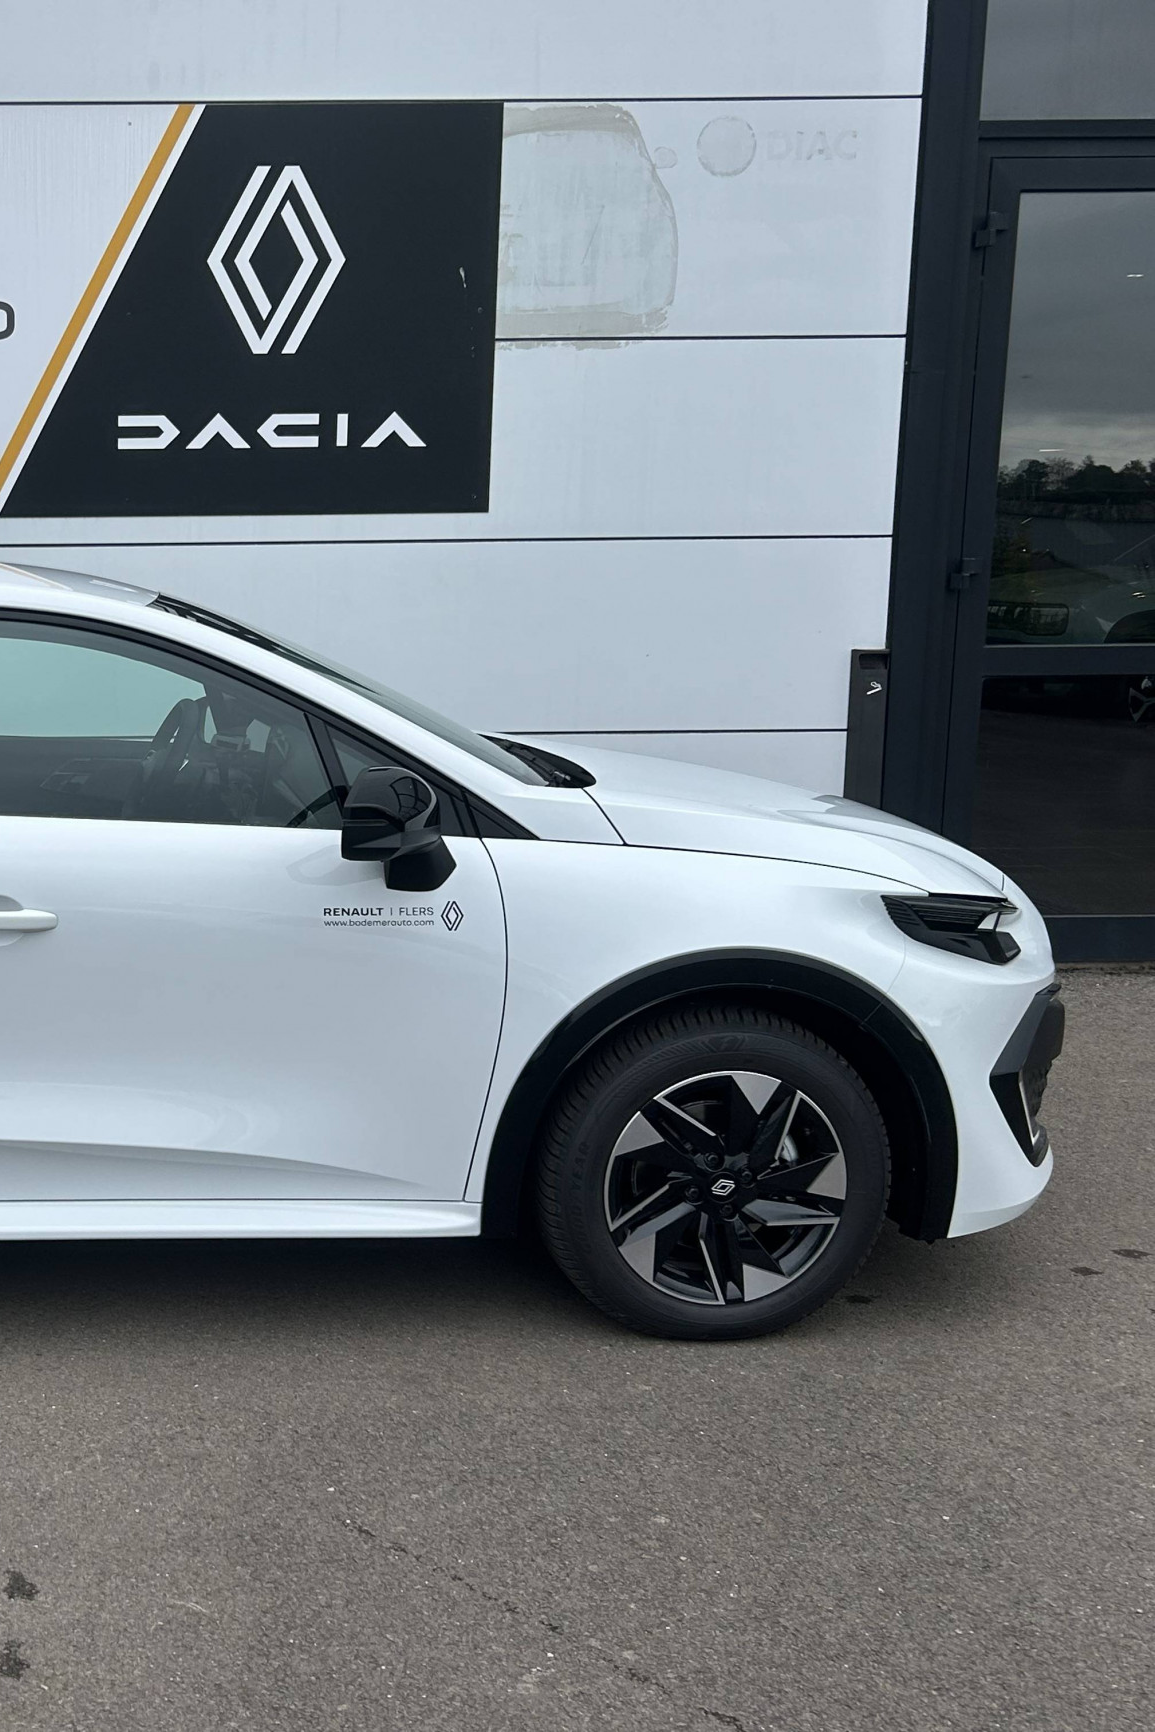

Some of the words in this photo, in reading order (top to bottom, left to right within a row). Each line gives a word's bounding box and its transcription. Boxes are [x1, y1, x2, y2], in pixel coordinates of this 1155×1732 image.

[118, 412, 426, 449] DACIA
[323, 907, 385, 917] RENAULT
[399, 907, 434, 916] FLERS
[323, 918, 435, 927] www.bodemerauto.com
